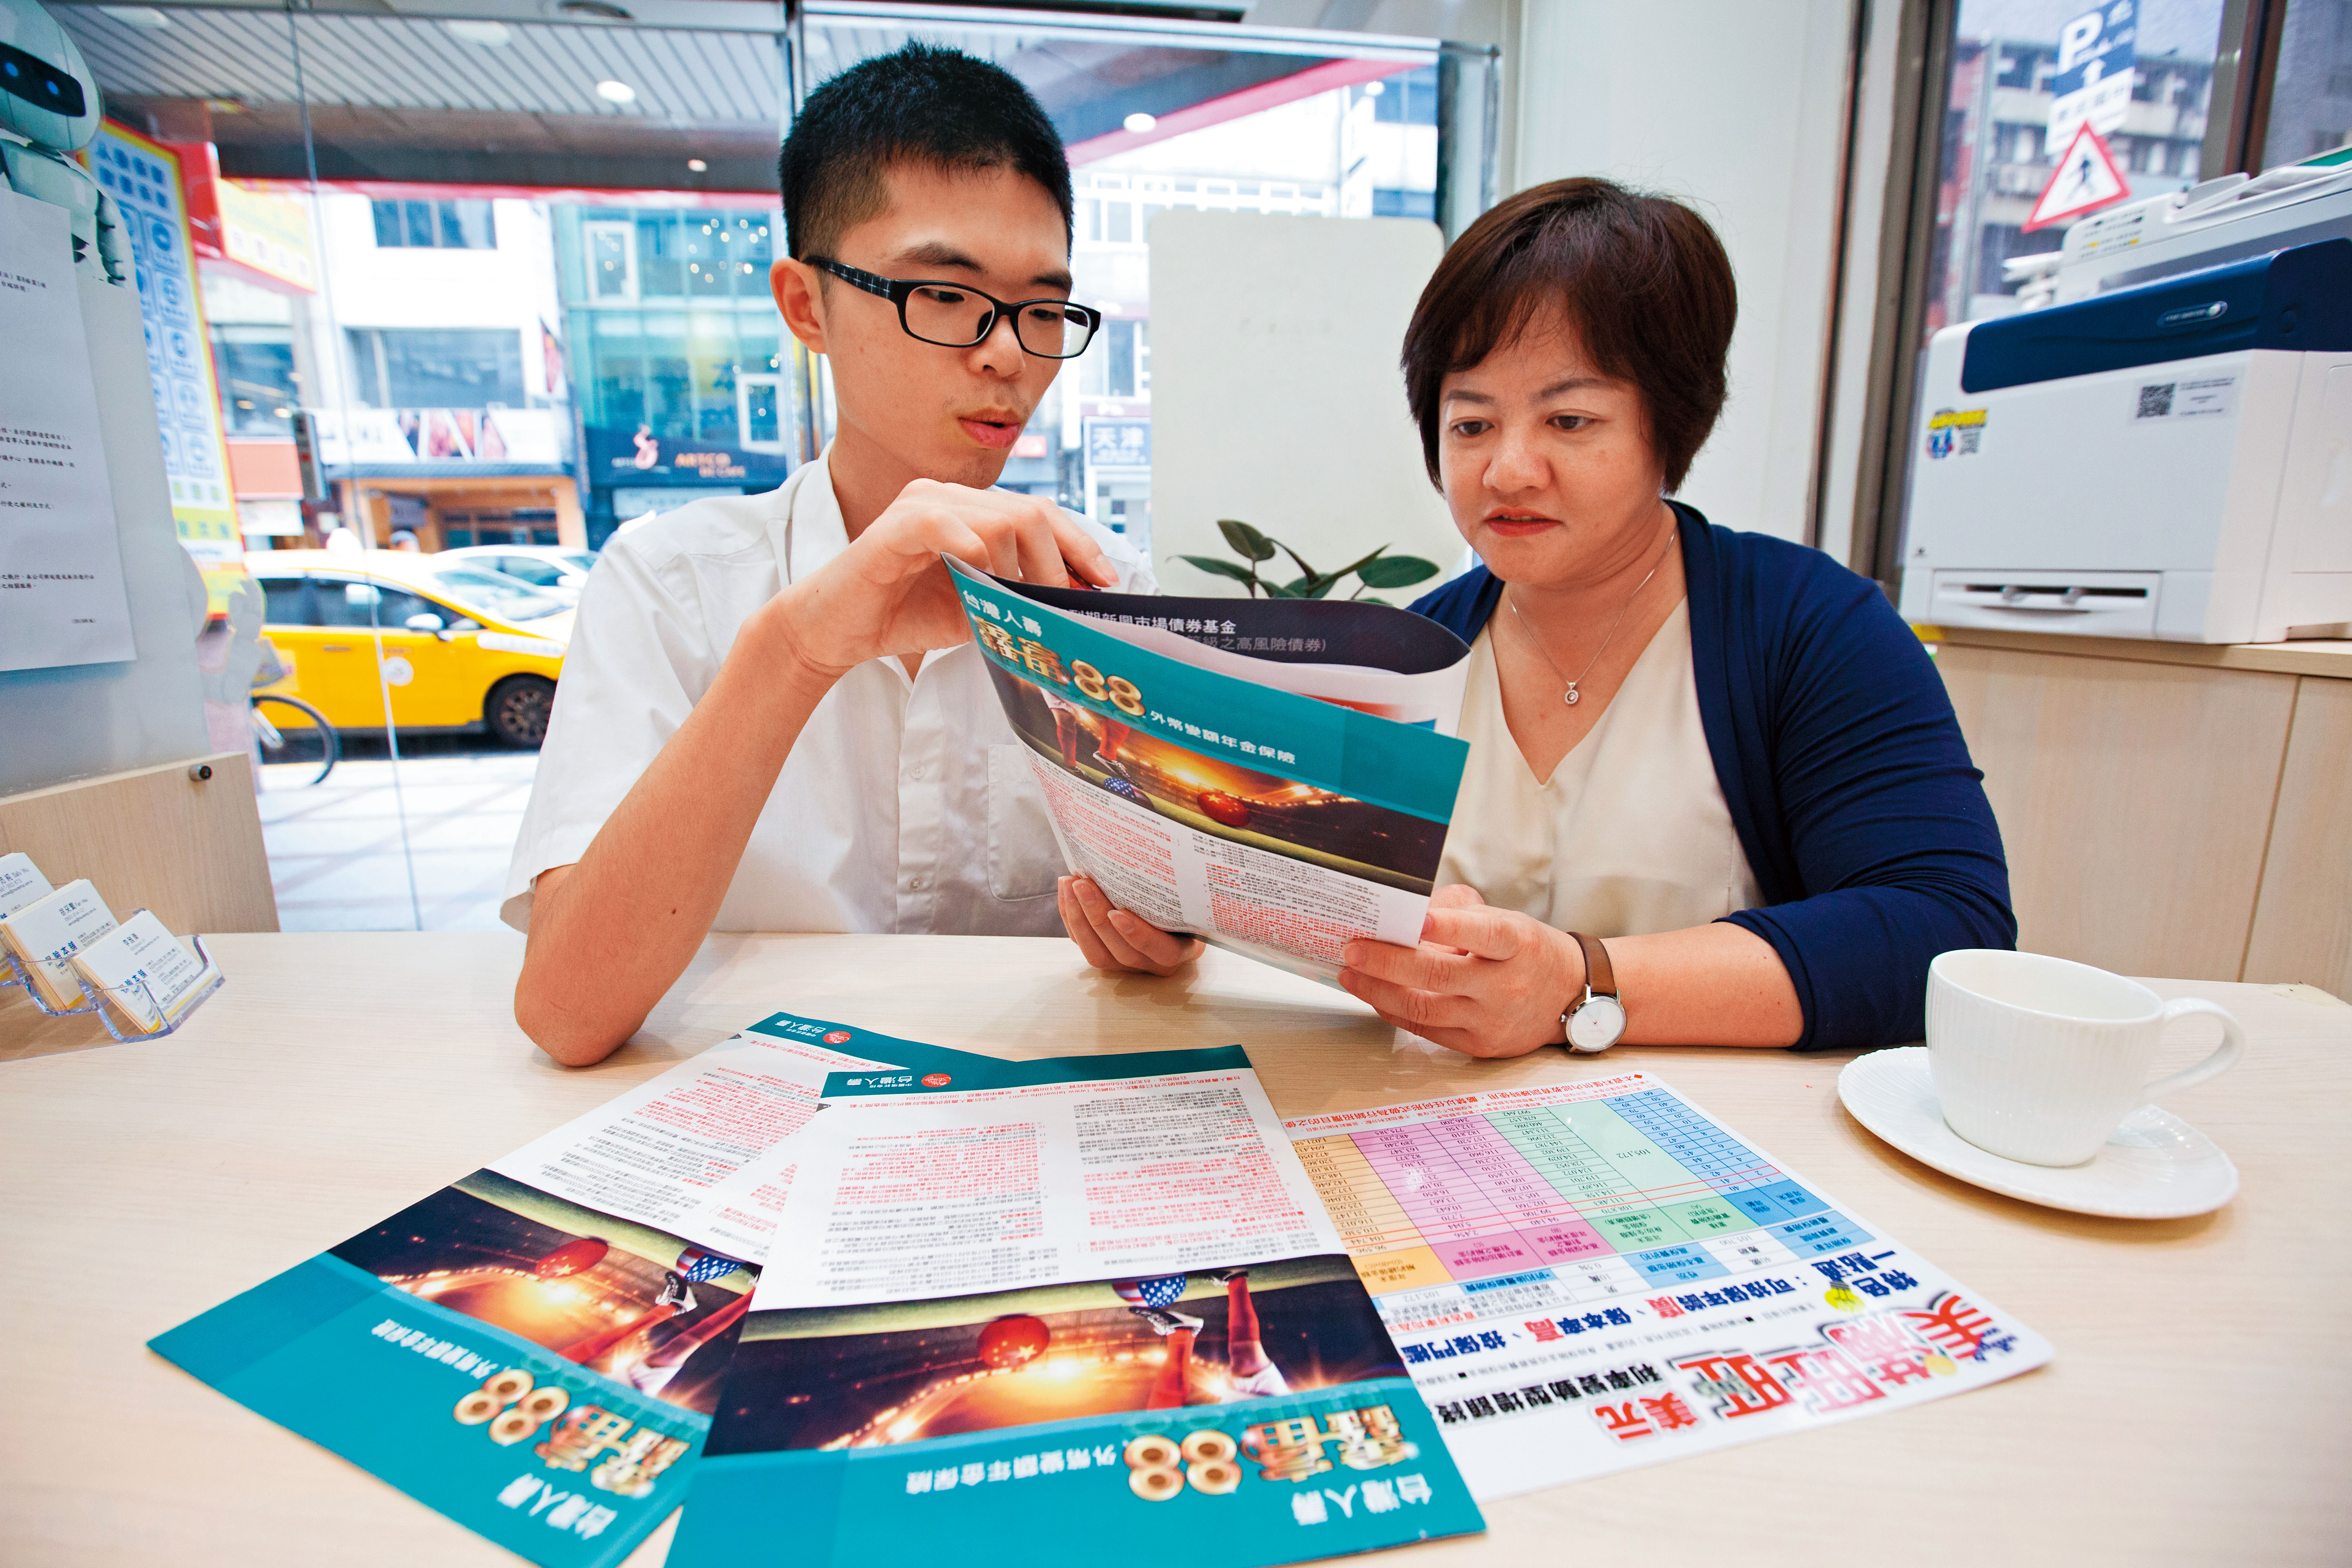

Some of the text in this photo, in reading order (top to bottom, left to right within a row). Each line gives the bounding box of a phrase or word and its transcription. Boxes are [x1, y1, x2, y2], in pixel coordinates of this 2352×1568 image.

[2058, 11, 2103, 75] P
[962, 590, 1042, 638] 台灣人壽
[1149, 709, 1296, 765] 外幣變額年金保險
[775, 1020, 826, 1034] 台灣人壽
[846, 1075, 913, 1086] 台灣人壽
[1440, 1117, 1470, 1125] 246,200
[1374, 1127, 1405, 1135] 775,385
[1445, 1123, 1475, 1131] 212,150
[1521, 1126, 1550, 1135] 313,347
[1379, 1134, 1409, 1142] 482,283
[1451, 1129, 1481, 1138] 182,810
[1383, 1140, 1415, 1148] 289,240
[1457, 1136, 1487, 1144] 157,520
[1294, 1145, 1325, 1153] 694,433
[1390, 1146, 1419, 1155] 163,347
[1462, 1142, 1493, 1151] 135,730
[1540, 1147, 1570, 1155] 139,302
[1298, 1152, 1329, 1160] 472,050
[1468, 1149, 1499, 1157] 116,960
[1548, 1153, 1577, 1161] 134,029
[1615, 1149, 1651, 1158] 105,172
[1303, 1158, 1334, 1167] 320,867
[1395, 1154, 1421, 1162] 82,377
[1474, 1156, 1506, 1164] 115,230
[1399, 1160, 1427, 1168] 31,302
[1481, 1163, 1512, 1171] 113,530
[1554, 1160, 1585, 1169] 128,952
[1307, 1165, 1339, 1174] 218,107
[1488, 1169, 1519, 1178] 111,850
[1561, 1167, 1592, 1176] 124,072
[1310, 1172, 1343, 1181] 148,262
[1570, 1174, 1600, 1183] 119,701
[1315, 1179, 1347, 1187] 142,646
[1494, 1177, 1526, 1186] 109,100
[1577, 1181, 1608, 1191] 116,897
[1319, 1186, 1352, 1195] 137,246
[1422, 1189, 1450, 1197] 16,850
[1501, 1184, 1533, 1193] 107,480
[1508, 1192, 1540, 1201] 105,370
[1584, 1189, 1616, 1198] 114,158
[1324, 1194, 1357, 1203] 132,046
[1429, 1196, 1456, 1205] 13,667
[1589, 1196, 1621, 1207] 111,483
[1329, 1201, 1363, 1211] 125,950
[1434, 1204, 1463, 1213] 10,642
[1515, 1199, 1548, 1209] 102,760
[1522, 1208, 1551, 1217] 99,700
[1600, 1204, 1633, 1214] 108,870
[1336, 1209, 1368, 1220] 121,147
[1440, 1212, 1466, 1221] 7,770
[1339, 1218, 1374, 1228] 116,012
[1448, 1221, 1472, 1230] 5,044
[1530, 1216, 1560, 1226] 94,140
[1345, 1226, 1379, 1236] 110,530
[1453, 1229, 1479, 1238] 2,456
[1350, 1234, 1385, 1245] 104,744
[1719, 1234, 1753, 1245] 105,700
[1356, 1245, 1386, 1253] 96,596
[1810, 1251, 1898, 1281] 一點通
[1849, 1268, 1923, 1298] 特色
[1403, 1290, 1440, 1302] 105,172
[1592, 1391, 1700, 1442] 美元
[906, 1443, 1116, 1494] 外幣變額年金保險
[1292, 1473, 1432, 1525] 台灣人壽
